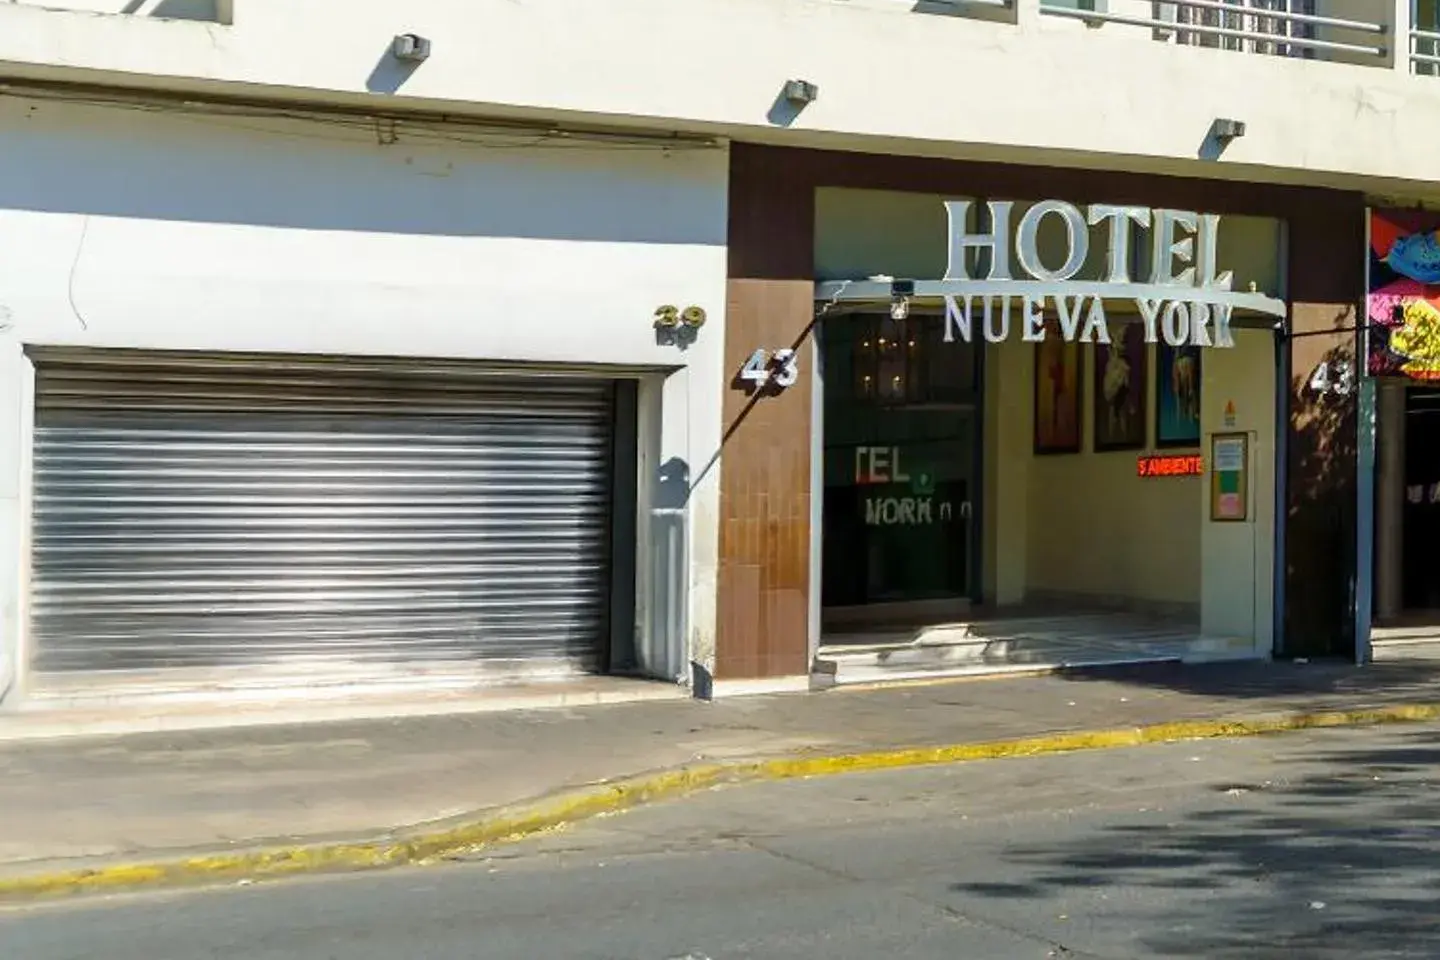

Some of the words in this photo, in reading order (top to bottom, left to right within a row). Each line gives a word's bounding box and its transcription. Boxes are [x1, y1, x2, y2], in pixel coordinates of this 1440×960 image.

[943, 199, 1234, 292] HOTEL
[654, 304, 707, 329] 39
[943, 294, 1112, 344] NUEVA
[1136, 297, 1235, 349] YORK
[741, 348, 798, 387] 43
[1310, 361, 1352, 395] 43
